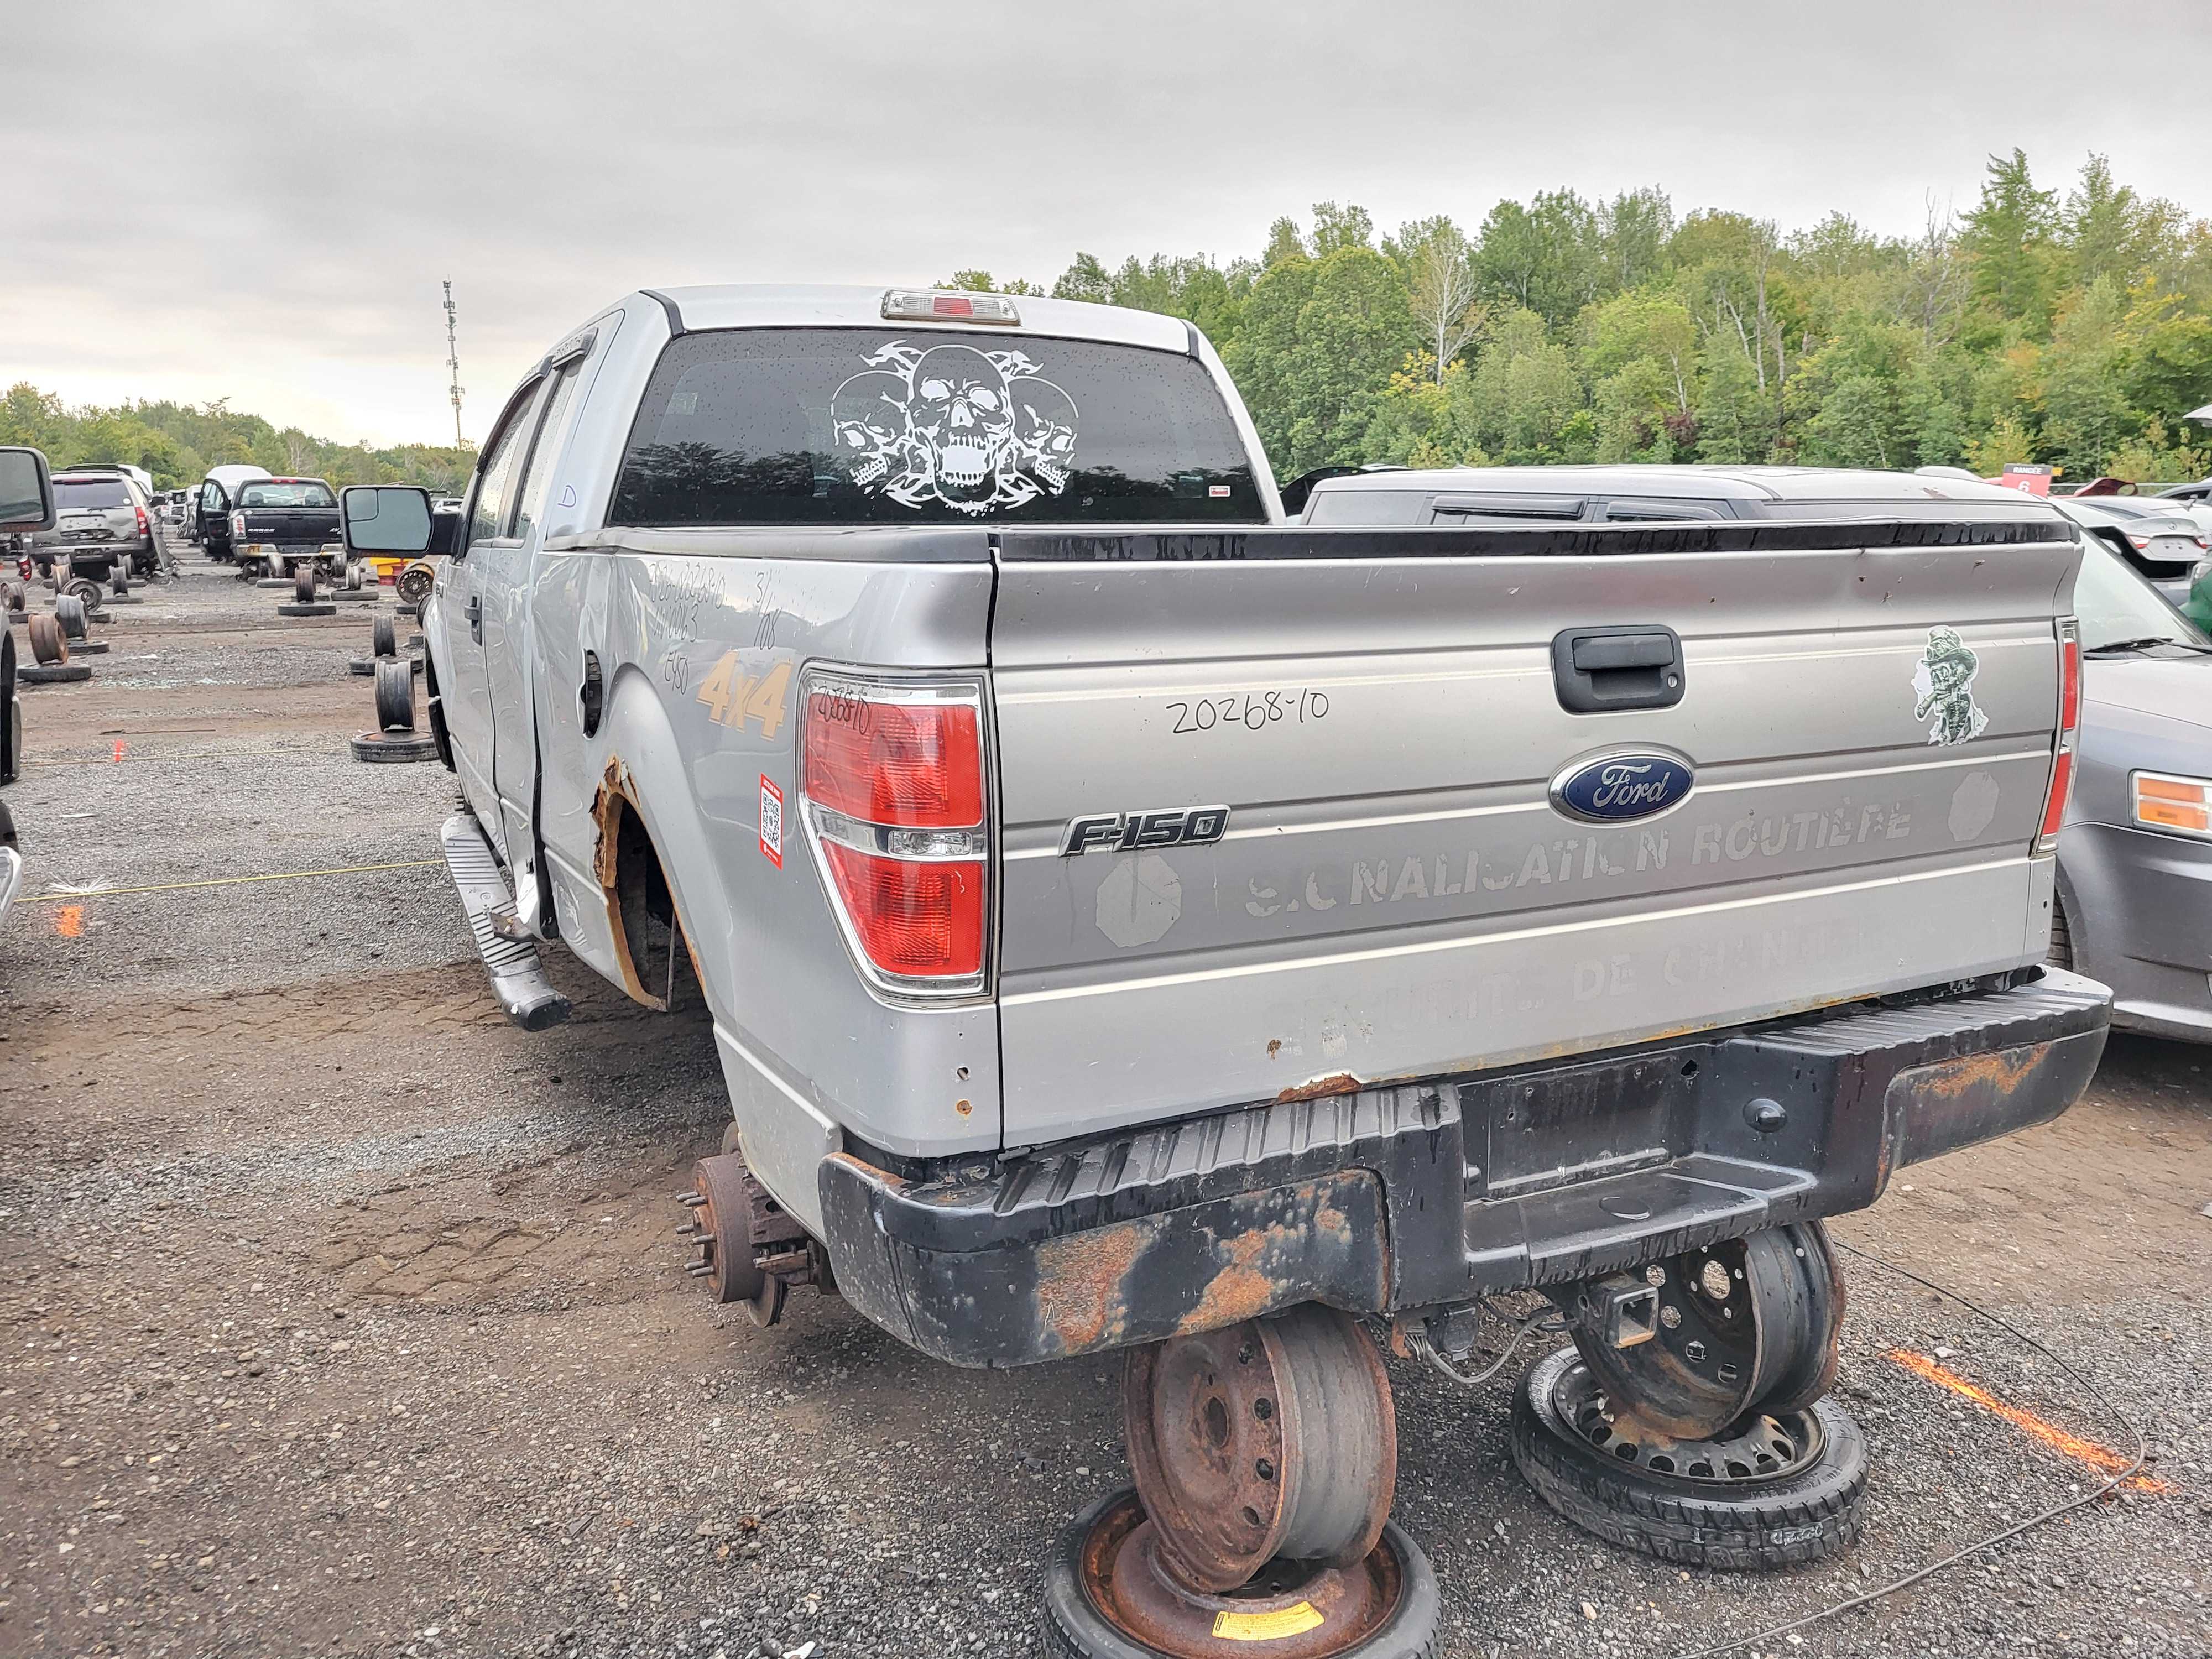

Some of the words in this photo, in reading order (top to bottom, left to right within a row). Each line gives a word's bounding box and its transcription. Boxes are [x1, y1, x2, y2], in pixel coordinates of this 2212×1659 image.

[2013, 466, 2043, 475] RANGÉE
[2018, 481, 2030, 492] 6
[557, 484, 576, 508] D
[1166, 688, 1329, 734] 20268-10
[1592, 764, 1671, 807] Ford
[1058, 804, 1231, 857] F-150
[1572, 952, 1638, 1002] DE
